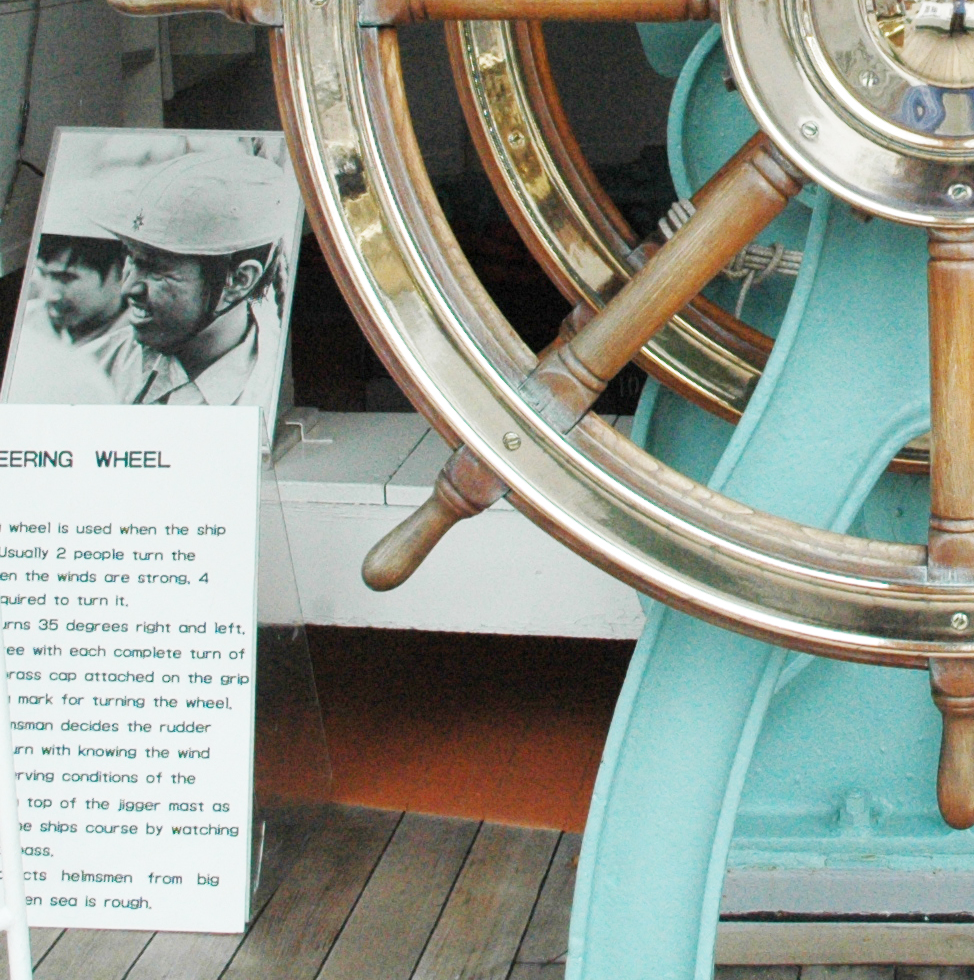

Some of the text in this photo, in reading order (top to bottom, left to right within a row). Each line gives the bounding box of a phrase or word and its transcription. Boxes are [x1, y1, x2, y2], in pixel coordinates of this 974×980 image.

[94, 449, 172, 469] WHEEL
[8, 521, 51, 534] wheel
[57, 522, 69, 535] is
[75, 522, 113, 535] used
[119, 523, 157, 536] when
[164, 523, 190, 536] the
[196, 523, 227, 537] ship
[0, 546, 196, 562] Usually 2 people turn the
[24, 569, 50, 583] the
[56, 570, 97, 583] winds
[104, 573, 131, 584] are
[198, 572, 209, 585] 4
[53, 595, 70, 606] to
[77, 595, 109, 607] turn
[38, 618, 59, 632] 35
[65, 619, 129, 634] degrees
[135, 621, 172, 635] right
[178, 621, 207, 634] and
[32, 644, 63, 657] with
[69, 644, 107, 658] each
[113, 646, 182, 660] complete
[189, 649, 222, 660] turn
[228, 647, 246, 661] of
[6, 670, 250, 686] rass cap attached on the grip
[17, 692, 54, 705] mark
[61, 693, 85, 706] for
[92, 695, 146, 709] turning
[153, 695, 179, 709] the
[60, 718, 120, 733] decides
[126, 720, 153, 733] the
[159, 720, 212, 734] rudder
[41, 743, 71, 756] with
[77, 744, 137, 760] knowing
[144, 746, 170, 759] the
[177, 746, 211, 760] wind
[61, 770, 139, 784] conditions
[145, 771, 163, 784] of
[170, 771, 197, 785] the
[27, 797, 53, 810] top
[59, 797, 77, 809] of
[84, 797, 110, 811] the
[117, 798, 162, 813] jigger
[168, 801, 205, 813] mast
[211, 802, 231, 813] as
[39, 820, 78, 834] ships
[85, 824, 139, 835] course
[145, 821, 164, 837] by
[171, 823, 240, 838] watching
[61, 869, 133, 884] helmsmen
[148, 871, 183, 885] from
[196, 872, 220, 888] big
[49, 896, 78, 907] sea
[84, 895, 97, 908] is
